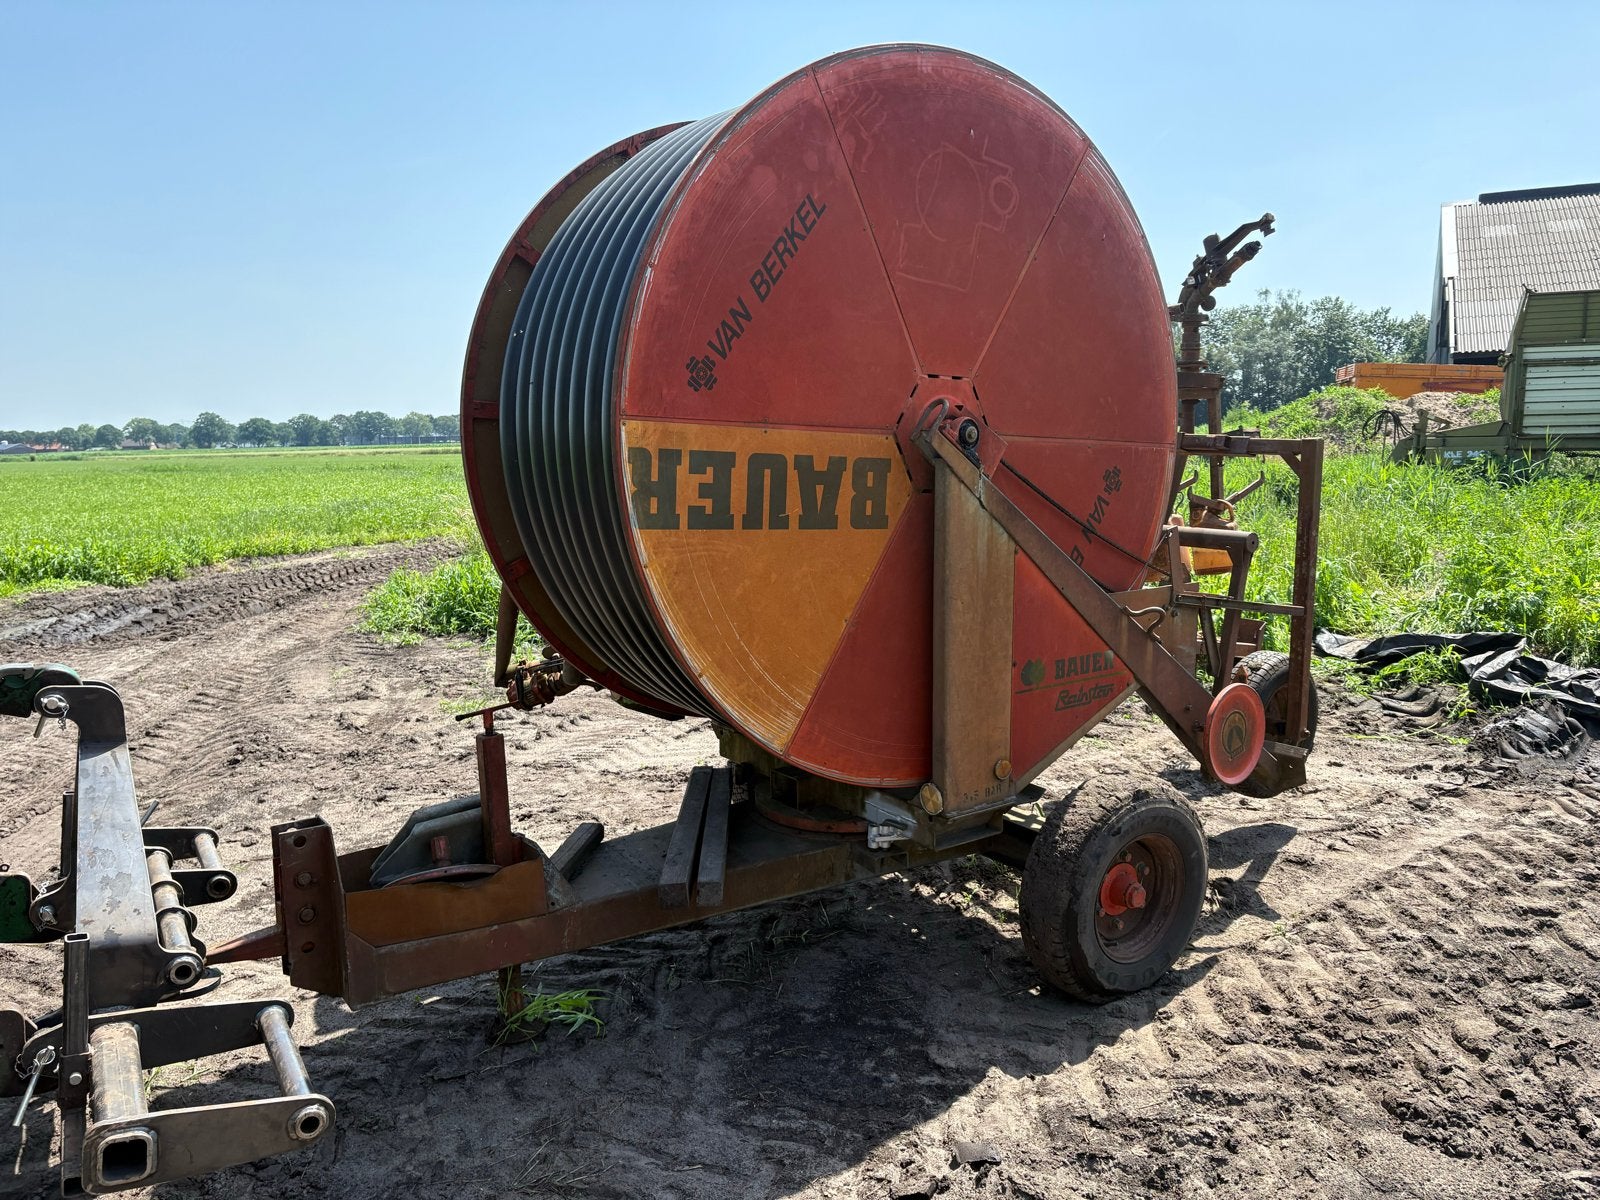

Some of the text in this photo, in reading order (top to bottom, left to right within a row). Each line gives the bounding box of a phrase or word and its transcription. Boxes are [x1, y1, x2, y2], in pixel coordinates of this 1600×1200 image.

[706, 193, 828, 361] VAN BERKEL
[627, 446, 893, 531] BAUER
[1081, 494, 1110, 545] VAN
[1055, 650, 1115, 680] BAUER
